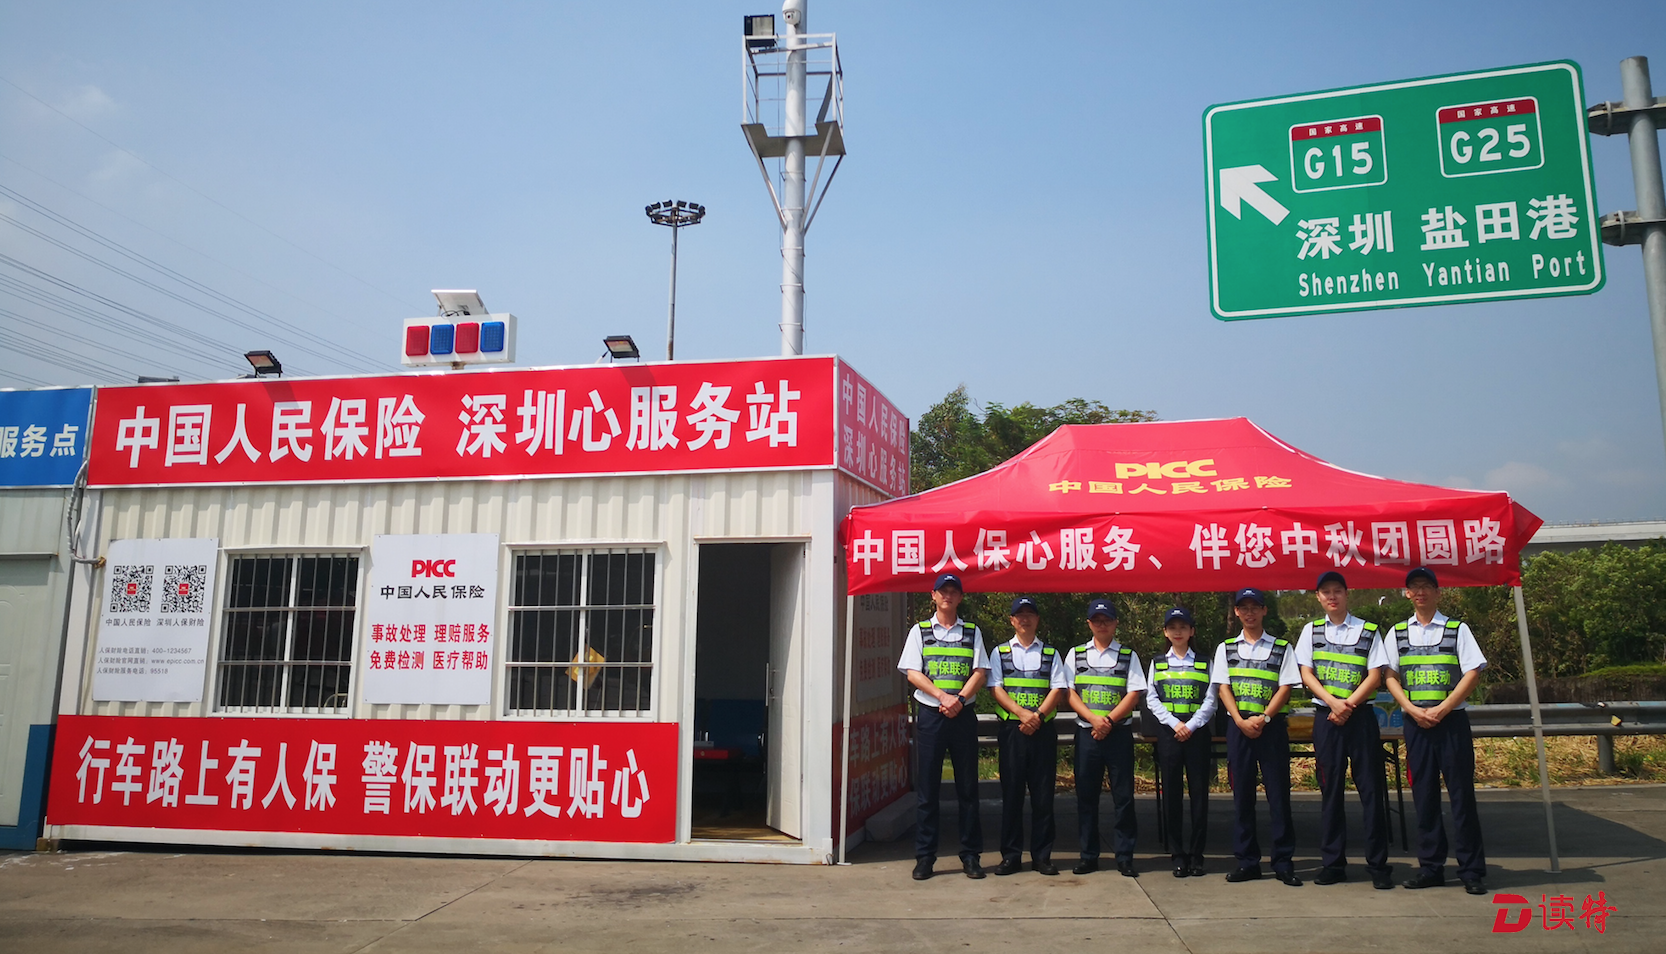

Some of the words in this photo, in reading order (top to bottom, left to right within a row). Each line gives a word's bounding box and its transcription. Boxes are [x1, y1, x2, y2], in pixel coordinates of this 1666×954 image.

[1457, 103, 1516, 118] 国家高速
[1308, 122, 1364, 137] 国家高速
[1450, 124, 1531, 164] G25
[1304, 142, 1373, 180] G15
[1295, 210, 1395, 260] 深圳
[1420, 194, 1580, 251] 盐田港
[1298, 268, 1400, 297] Shenzhen
[1422, 257, 1510, 287] Yantian
[1532, 250, 1586, 279] Port
[115, 394, 426, 468] 中国人民保险
[456, 380, 801, 458] 深圳心服务站
[842, 373, 906, 455] 中国人民保险
[0, 424, 79, 458] 服务点
[1115, 459, 1217, 479] PICC
[1048, 475, 1292, 495] 中国人民保险
[411, 559, 456, 577] PICC
[380, 585, 485, 600] 中国人民保险
[105, 618, 151, 627] 中国人民保险
[156, 618, 205, 627] 深圳人保财险
[371, 623, 426, 643] 事故处理
[434, 623, 490, 643] 理赔服务
[370, 650, 424, 670] 免费检测
[433, 650, 488, 670] 医疗帮助
[928, 660, 970, 677] 警保联动
[1316, 665, 1362, 686] 警保联动
[1406, 670, 1451, 686] 警保联动
[1082, 689, 1121, 705] 警保联动
[1231, 681, 1273, 700] 警保联动
[841, 714, 908, 768] 车路上有人保
[75, 735, 337, 811] 行车路上有人保
[362, 740, 650, 818] 警保联动更贴心
[841, 757, 908, 818] 保联动更贴心
